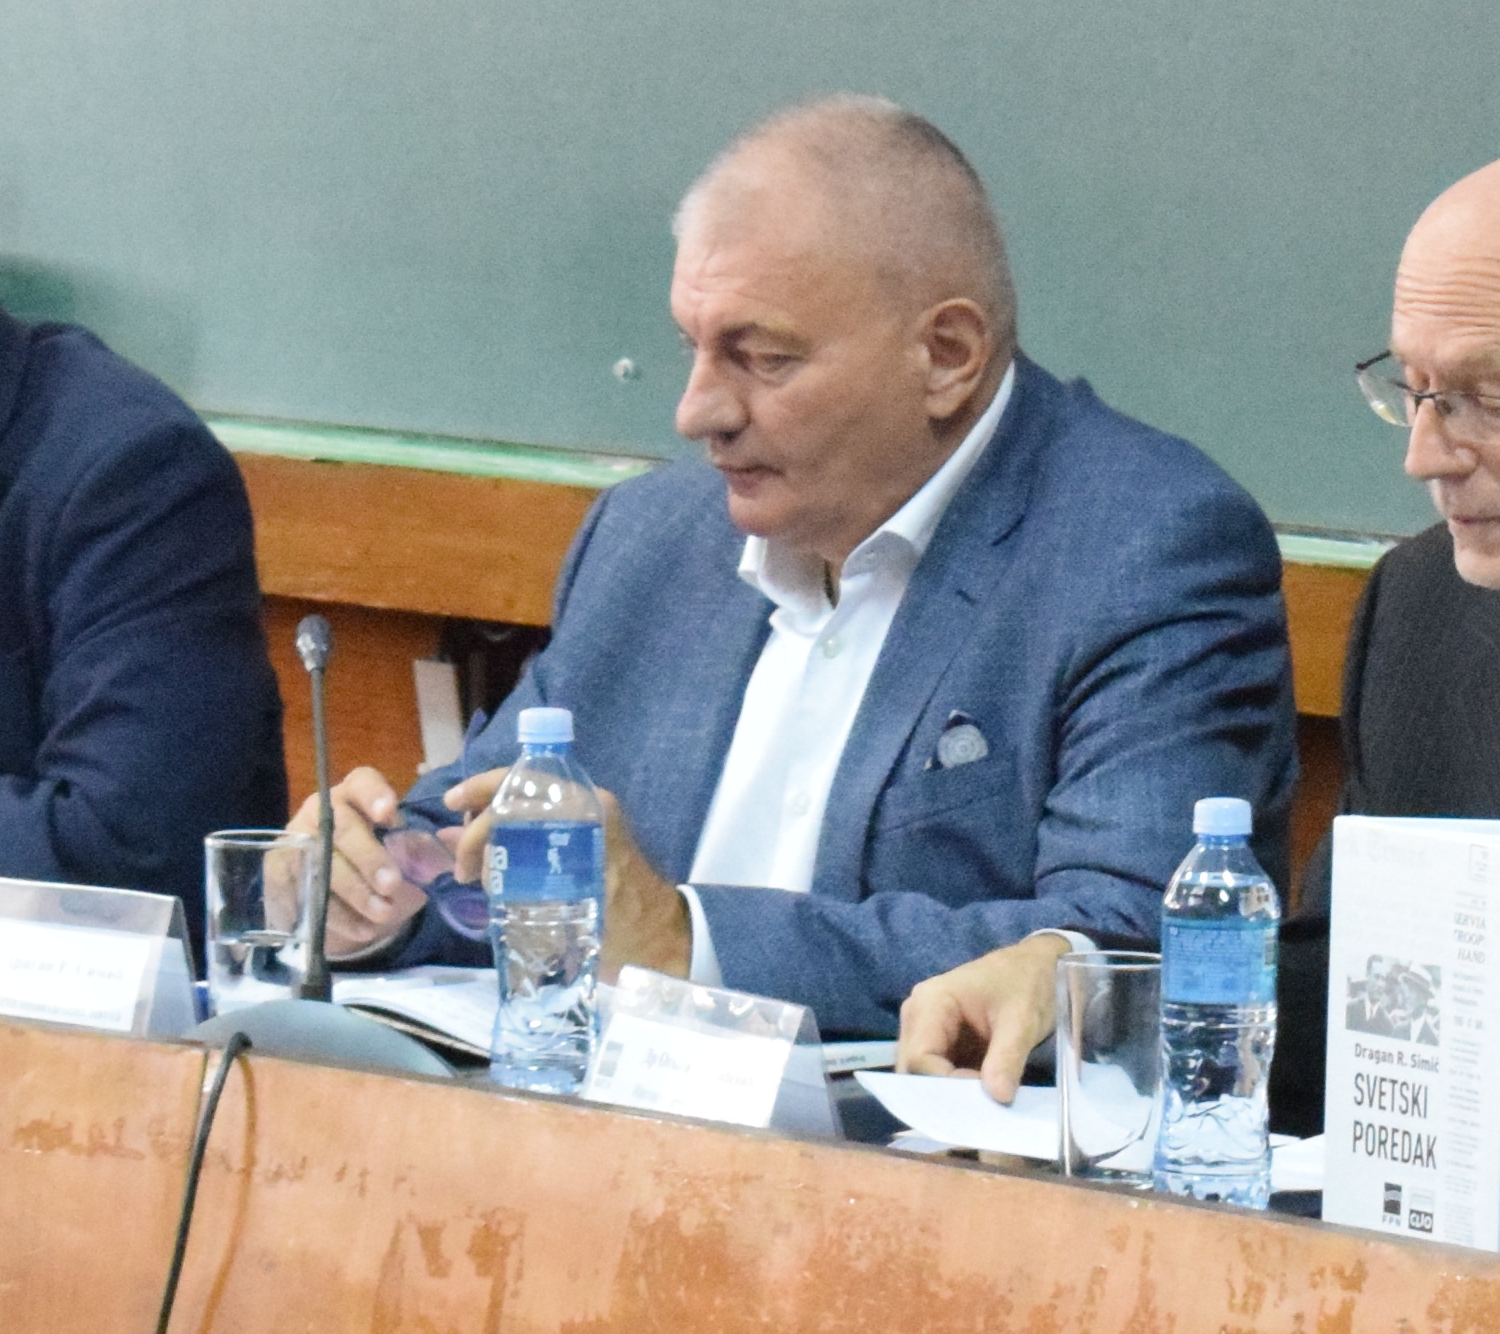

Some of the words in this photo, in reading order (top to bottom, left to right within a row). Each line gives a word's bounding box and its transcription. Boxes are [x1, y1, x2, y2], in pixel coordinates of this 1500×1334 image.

[1354, 1043, 1393, 1066] Dragan
[1397, 1051, 1408, 1067] R.
[1411, 1053, 1440, 1073] Simić
[1353, 1072, 1428, 1119] SVETSKI
[1352, 1120, 1438, 1170] POREDAK
